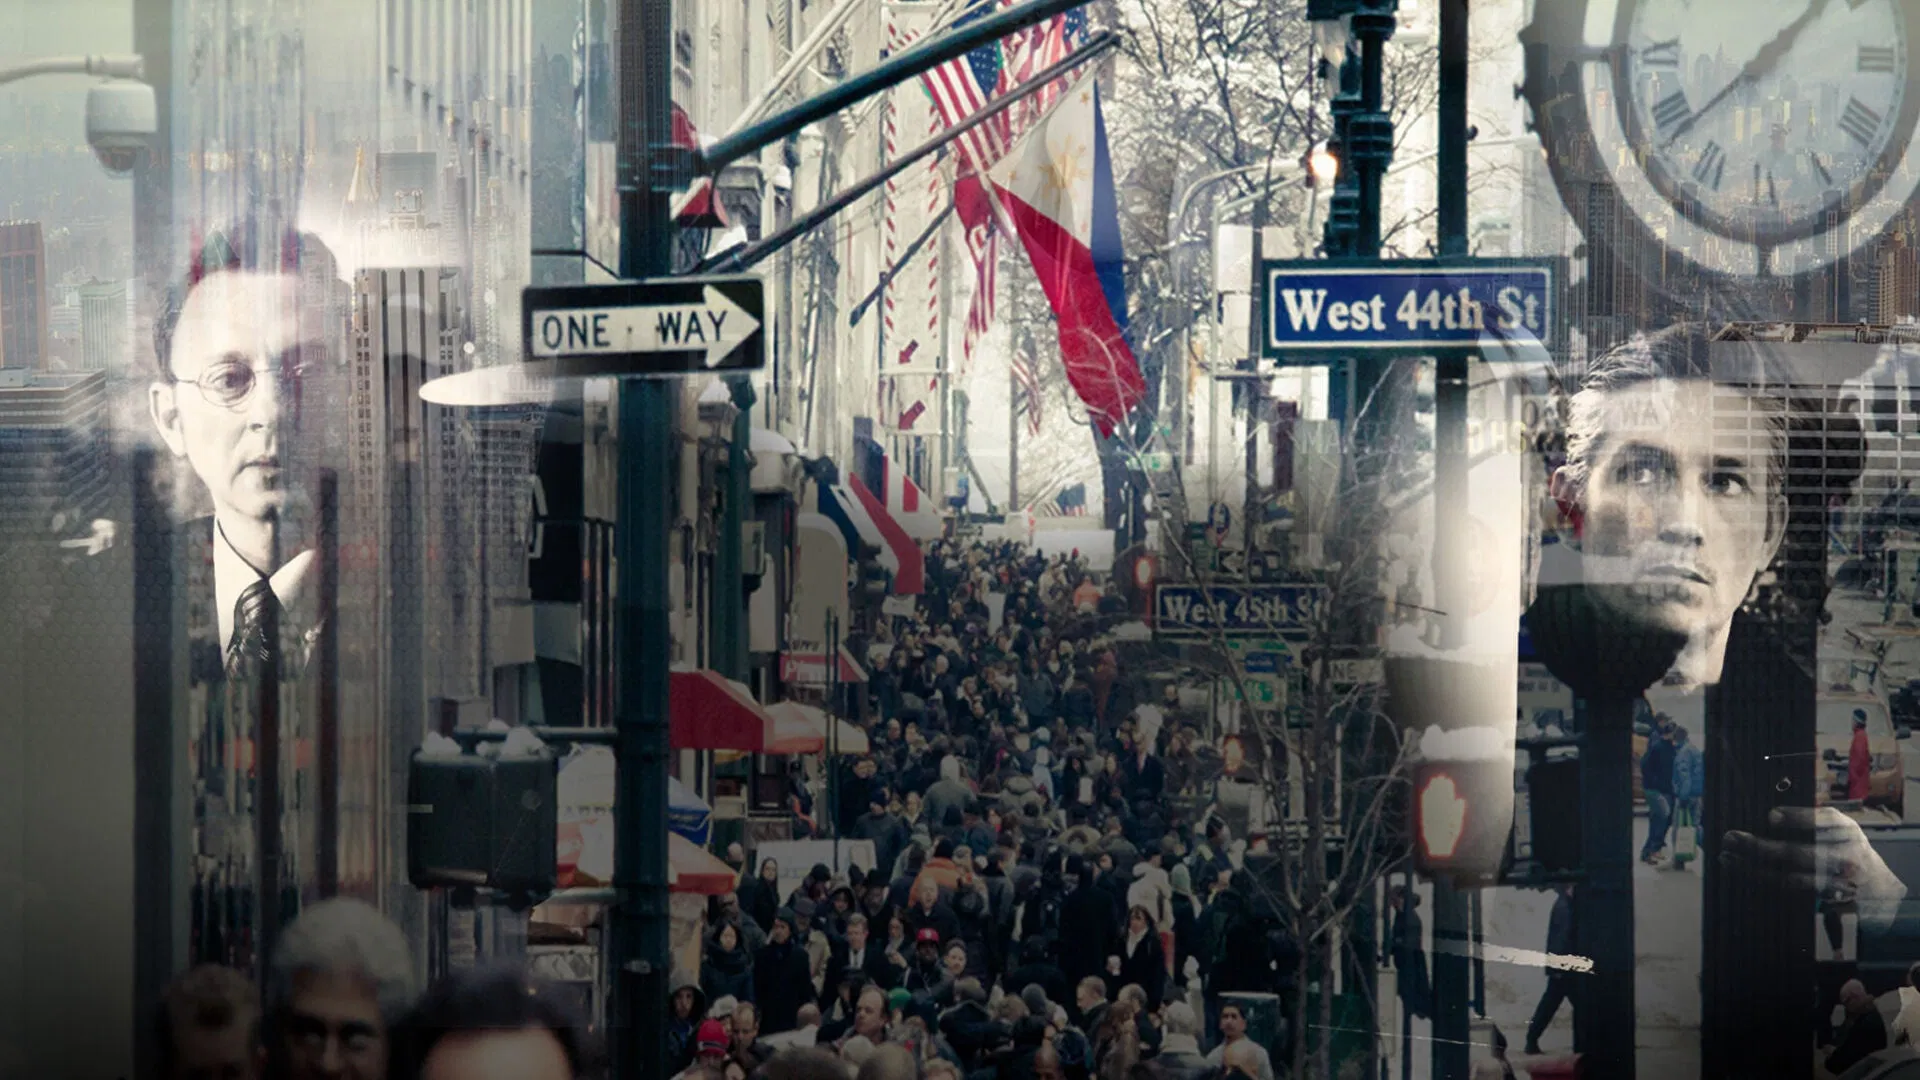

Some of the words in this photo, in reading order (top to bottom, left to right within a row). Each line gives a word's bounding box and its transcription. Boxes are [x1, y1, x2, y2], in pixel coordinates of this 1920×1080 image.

[543, 314, 611, 350] ONE
[658, 309, 728, 345] WAY
[1281, 288, 1386, 333] West
[1396, 286, 1484, 332] 44th
[1496, 285, 1540, 331] St
[1164, 595, 1227, 625] West
[1234, 594, 1288, 624] 45th
